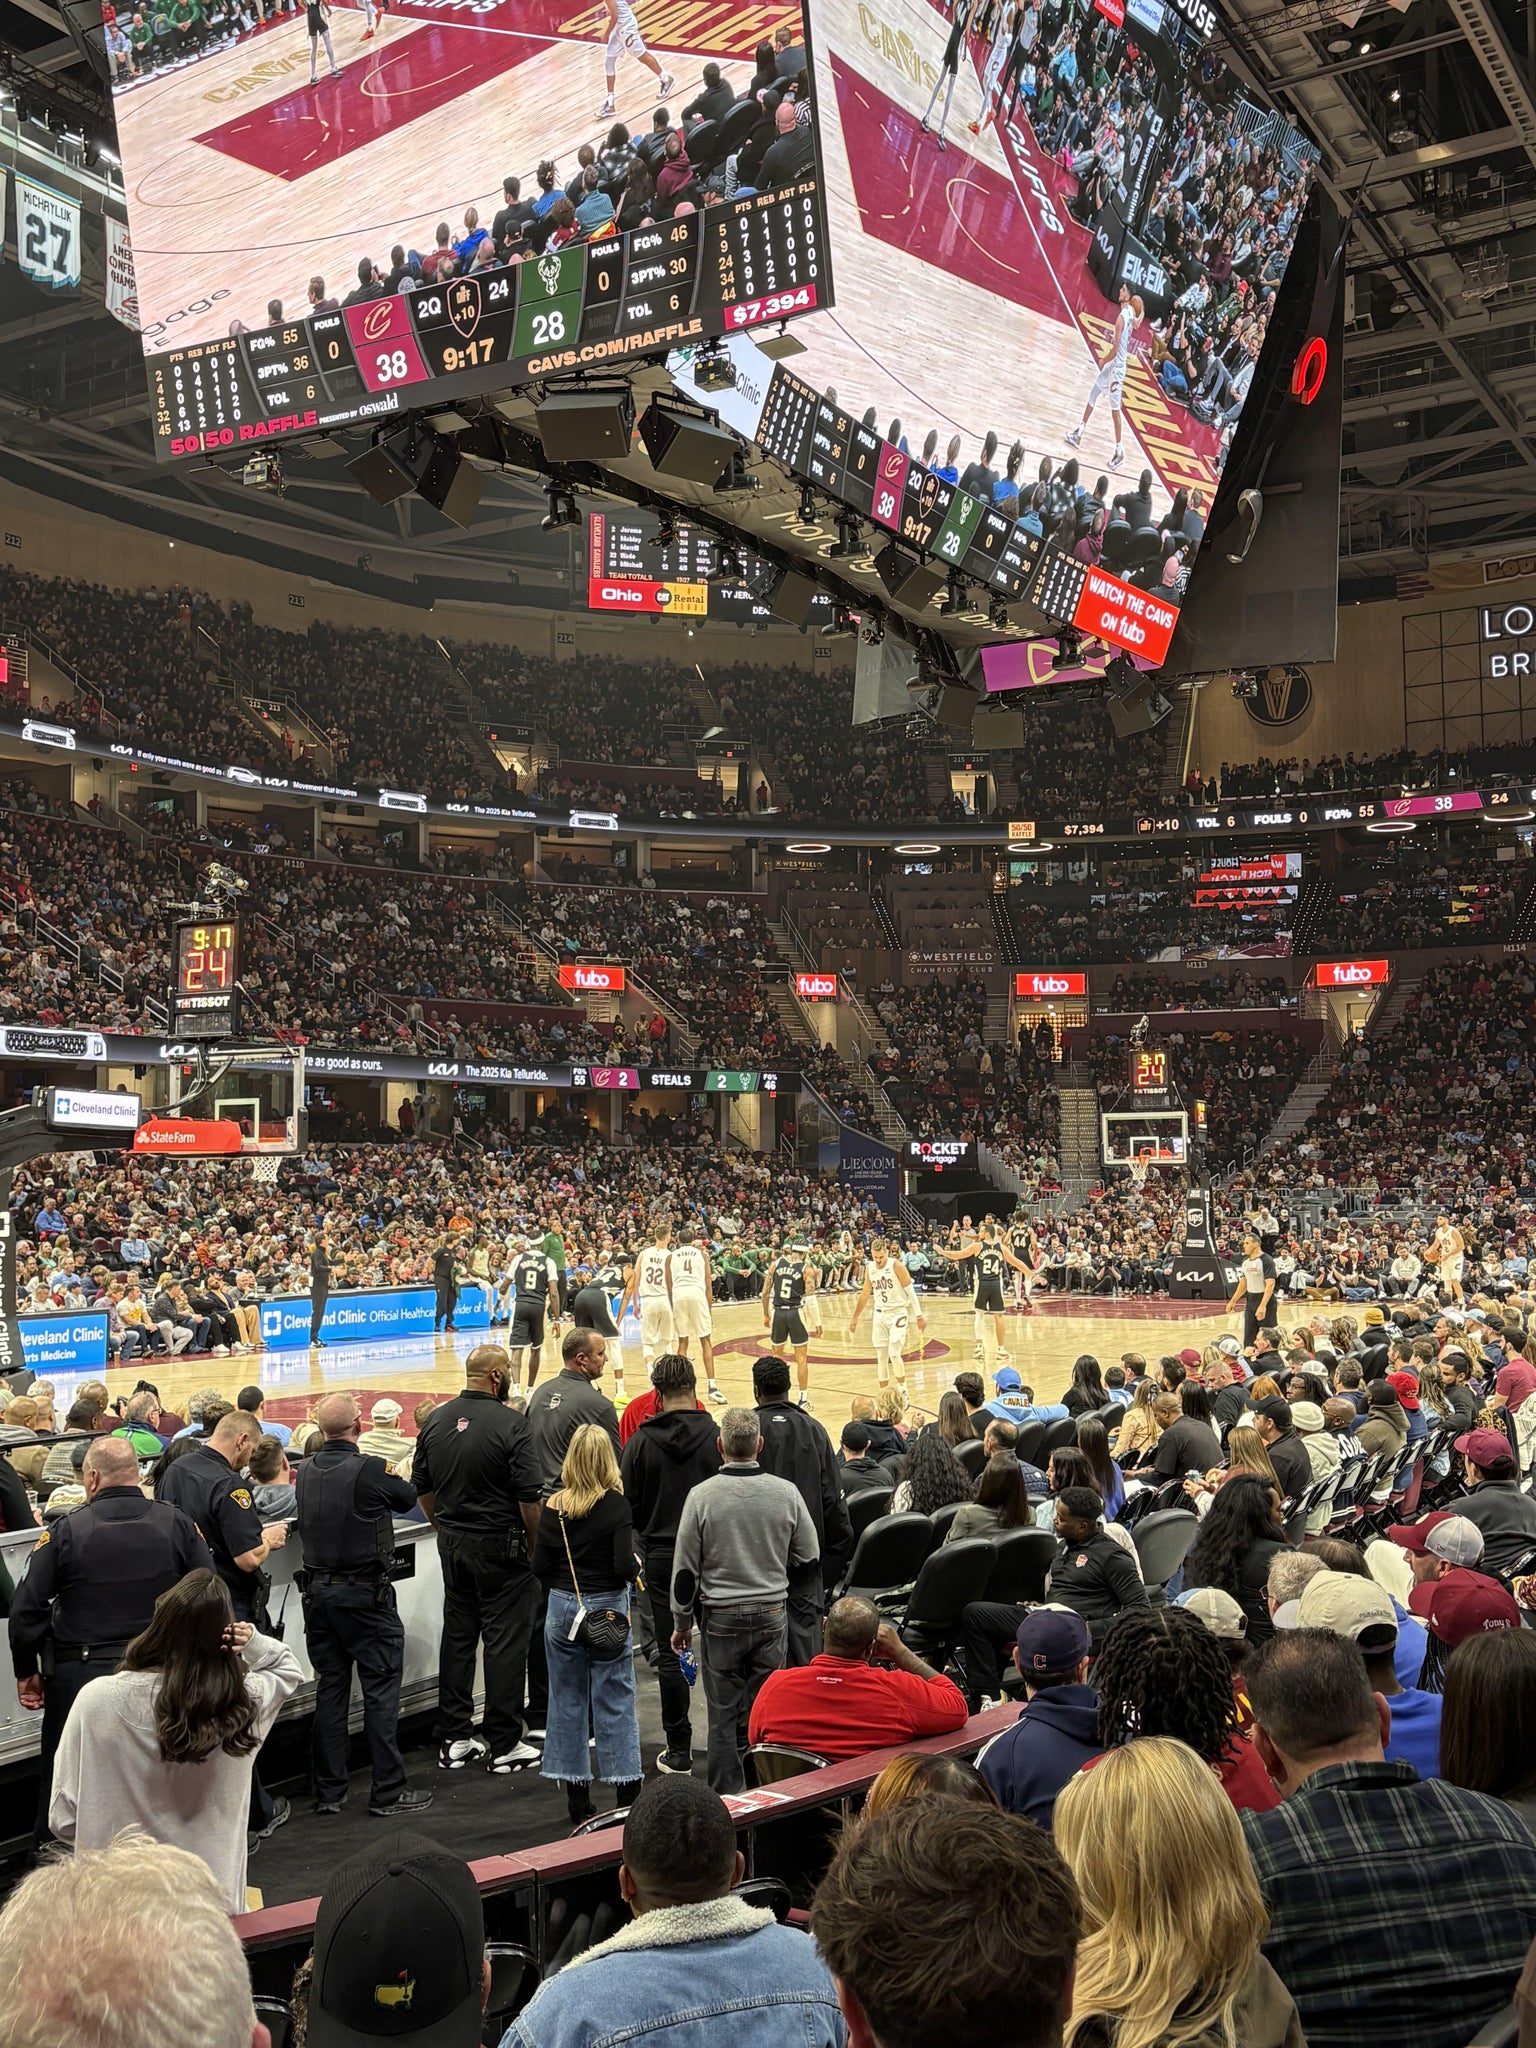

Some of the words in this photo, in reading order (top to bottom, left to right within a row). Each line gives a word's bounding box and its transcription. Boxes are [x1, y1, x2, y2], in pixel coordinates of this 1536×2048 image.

[735, 201, 752, 214] PTS
[757, 193, 775, 208] REB
[778, 187, 796, 201] AST
[798, 180, 816, 194] FLS
[718, 223, 727, 237] 5
[739, 216, 749, 231] 0
[761, 210, 769, 225] 1
[783, 203, 792, 218] 0
[802, 197, 812, 211] 0
[633, 232, 663, 252] FG%
[670, 224, 689, 243] 46
[720, 239, 729, 253] 9
[741, 233, 750, 247] 7
[763, 226, 770, 241] 1
[785, 219, 793, 234] 1
[804, 214, 813, 228] 0
[25, 212, 71, 275] 27
[591, 242, 621, 259] FOULS
[718, 254, 734, 271] 24
[742, 249, 752, 263] 3
[764, 242, 772, 257] 1
[786, 236, 795, 250] 0
[806, 231, 815, 245] 0
[631, 265, 666, 285] 3PT%
[669, 257, 687, 276] 30
[720, 270, 735, 286] 34
[744, 266, 753, 279] 9
[766, 259, 775, 274] 2
[788, 253, 797, 267] 0
[807, 247, 816, 261] 0
[489, 279, 509, 301] 24
[598, 271, 610, 292] 0
[721, 286, 737, 302] 44
[745, 282, 755, 296] 0
[767, 276, 777, 290] 2
[789, 269, 797, 283] 1
[809, 263, 818, 278] 0
[418, 297, 442, 319] 2Q
[454, 305, 476, 322] +10
[627, 302, 653, 320] TOL
[669, 294, 680, 311] 6
[733, 289, 810, 325] $7,394
[313, 317, 341, 331] FOULS
[532, 310, 566, 346] 28
[249, 336, 276, 352] FG%
[282, 328, 298, 345] 55
[527, 318, 703, 375] CAVS.COM/RAFFLE
[328, 341, 340, 360] 0
[443, 337, 495, 372] 9:17
[257, 362, 289, 379] 3PT%
[293, 355, 309, 371] 36
[376, 350, 408, 383] 38
[267, 391, 291, 407] TOL
[306, 385, 316, 399] 6
[736, 372, 761, 405] Clinic
[239, 410, 318, 441] RAFFLE
[359, 392, 399, 416] oswald
[878, 491, 895, 518] 38
[904, 516, 931, 545] 9:17
[942, 531, 961, 557] 28
[601, 587, 643, 602] Ohio
[674, 594, 704, 604] Rental
[1089, 575, 1123, 605] WATCH
[1125, 595, 1145, 616] THE
[1145, 603, 1173, 628] CAVS
[1101, 613, 1116, 631] ON
[1118, 616, 1145, 644] fubo
[1434, 797, 1453, 811] 38
[1491, 793, 1509, 805] 24
[1196, 818, 1220, 828] TOL
[1226, 815, 1236, 827] 6
[1254, 813, 1293, 825] FOULS
[1299, 811, 1308, 823] 0
[1324, 809, 1352, 820] FG%
[1359, 805, 1375, 818] 55
[1064, 824, 1104, 836] $7,394
[1156, 818, 1180, 831] +10
[193, 927, 231, 950] 9:17
[923, 952, 993, 961] WESTFIELD
[186, 950, 226, 989] 24
[574, 969, 610, 988] fubo
[1333, 965, 1372, 982] fubo
[799, 977, 833, 994] fubo
[1032, 976, 1070, 993] fubo
[191, 996, 231, 1008] TISSOT
[315, 1056, 326, 1067] as
[327, 1056, 349, 1071] good
[350, 1059, 361, 1069] as
[362, 1060, 383, 1071] ours.
[465, 1065, 480, 1077] The
[481, 1066, 499, 1078] 2025
[500, 1067, 512, 1079] Kia
[513, 1068, 549, 1081] Telluride.
[618, 1072, 628, 1087] 2
[651, 1074, 692, 1086] STEALS
[717, 1074, 727, 1089] 2
[1137, 1065, 1164, 1086] 24
[72, 1102, 113, 1115] Cleveland
[114, 1105, 137, 1117] Clinic
[910, 1142, 969, 1155] ROCKET
[922, 1155, 957, 1164] Mortgage
[1014, 1236, 1026, 1248] 44
[683, 1259, 693, 1274] 4
[983, 1259, 999, 1275] 24
[525, 1271, 537, 1290] 9
[645, 1267, 664, 1286] 32
[780, 1279, 793, 1299] 5
[337, 1309, 367, 1325] Clinic
[369, 1309, 399, 1323] Official
[73, 1326, 104, 1343] Clinic
[41, 1349, 77, 1362] Medicine
